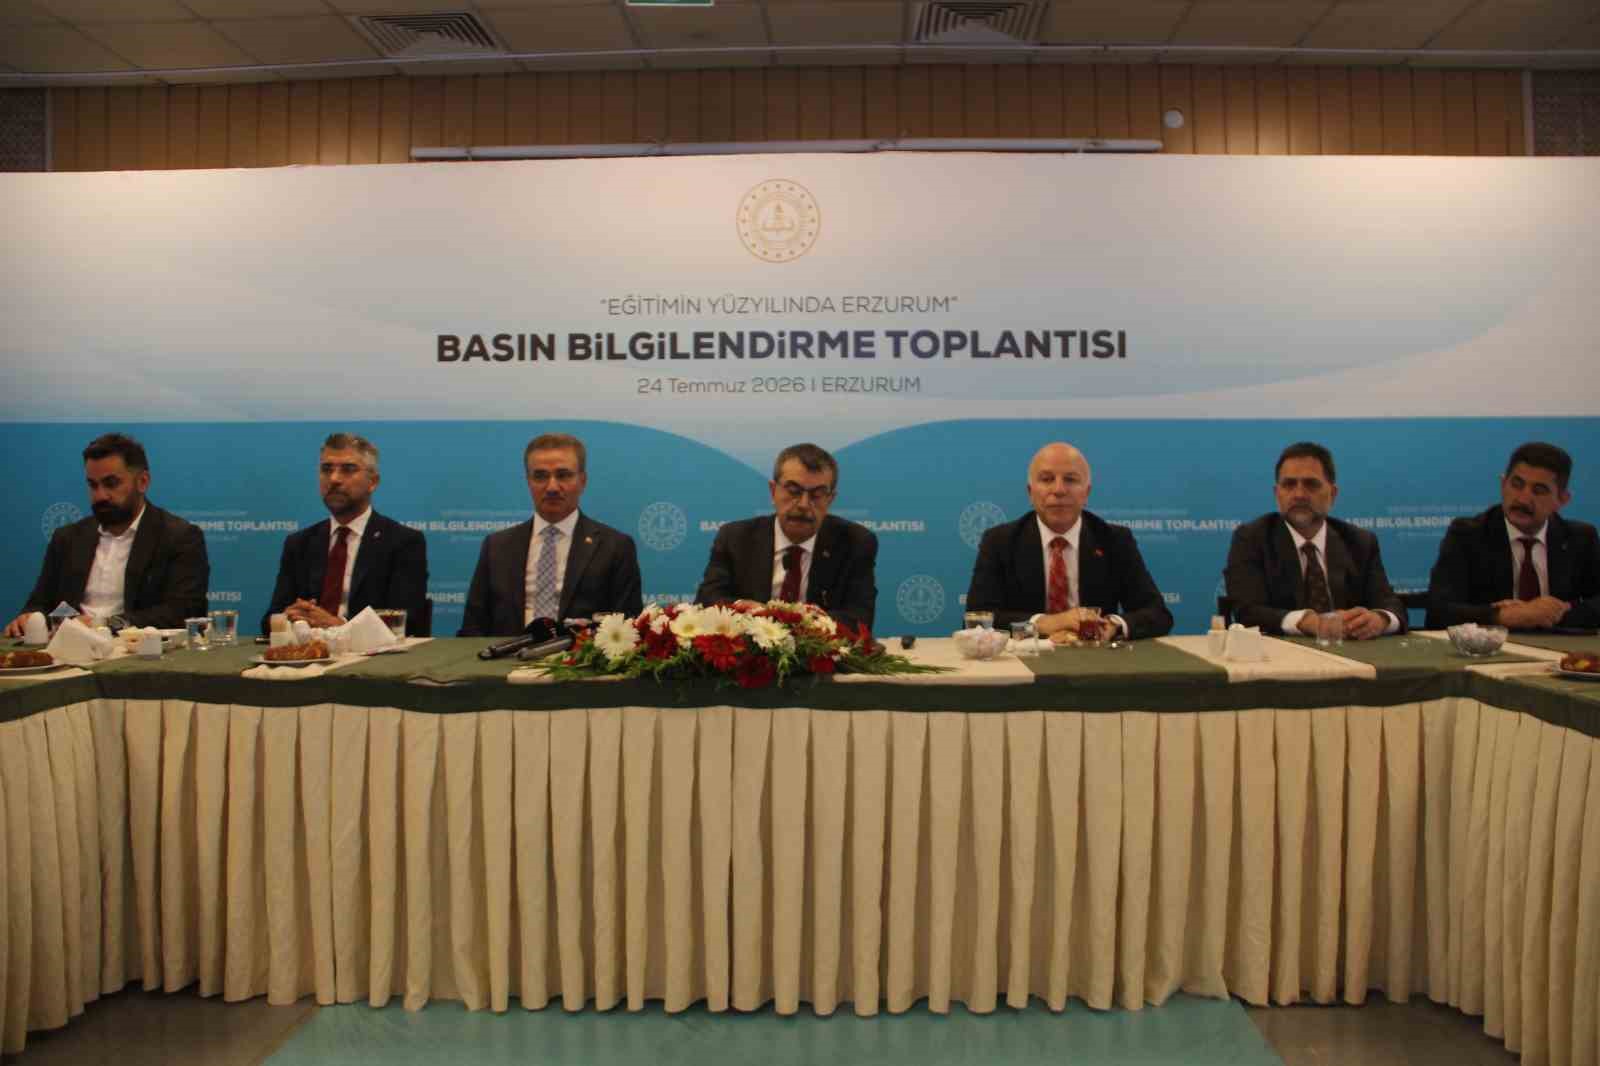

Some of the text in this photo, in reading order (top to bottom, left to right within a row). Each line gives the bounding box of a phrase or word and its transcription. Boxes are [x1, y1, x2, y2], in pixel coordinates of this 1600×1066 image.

[707, 293, 836, 315] YÜZYILINDA
[437, 333, 556, 362] BASIN
[885, 329, 1127, 359] TOPLANTISI
[637, 378, 662, 393] 24
[668, 377, 746, 393] Temmuz
[751, 376, 805, 392] 2026
[821, 376, 921, 392] ERZURUM
[228, 520, 299, 531] TOPLANTISI
